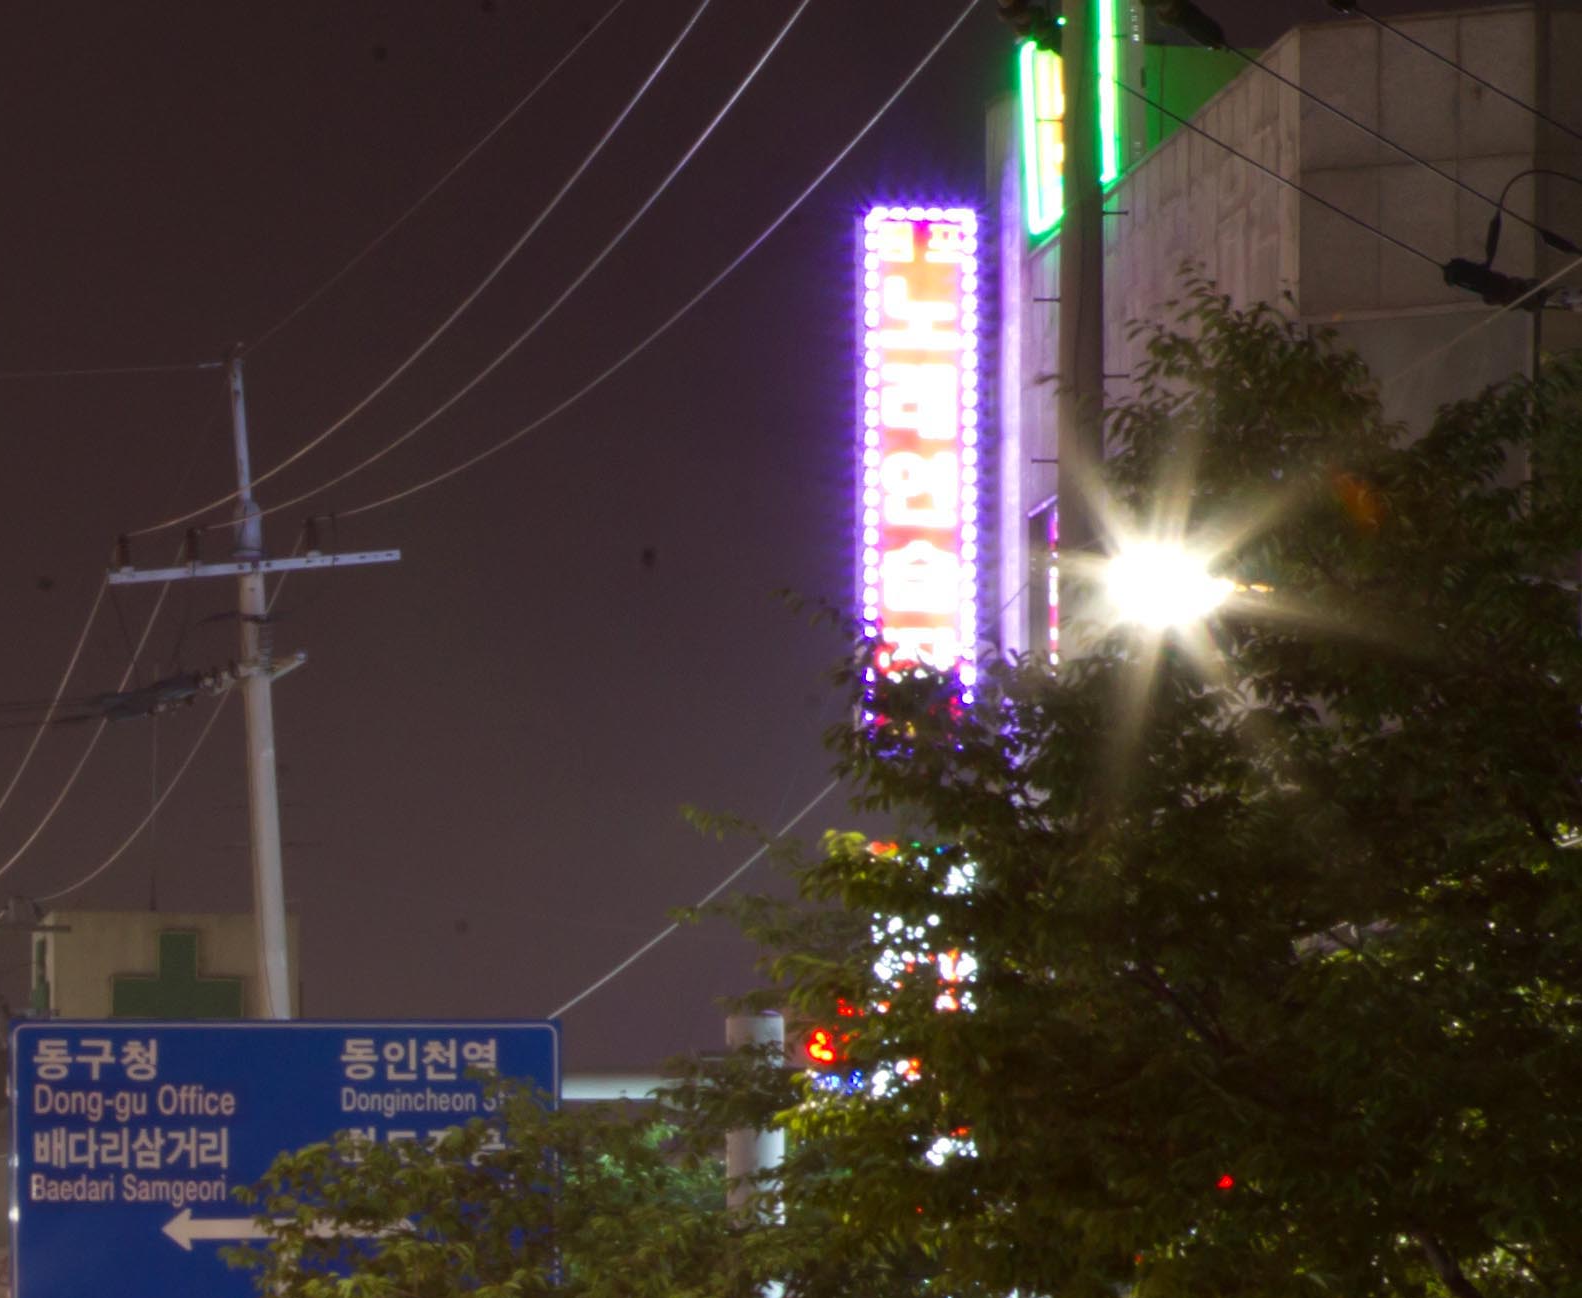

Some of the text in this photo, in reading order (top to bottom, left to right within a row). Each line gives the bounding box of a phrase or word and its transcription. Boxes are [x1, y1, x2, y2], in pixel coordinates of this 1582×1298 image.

[33, 1038, 159, 1081] 동구청
[340, 1038, 498, 1081] 동인천역
[35, 1084, 236, 1122] Dong-gu Office
[341, 1086, 477, 1118] Dongincheon
[33, 1126, 229, 1170] 배다리삼거리
[31, 1173, 227, 1208] Baedari Samgeori
